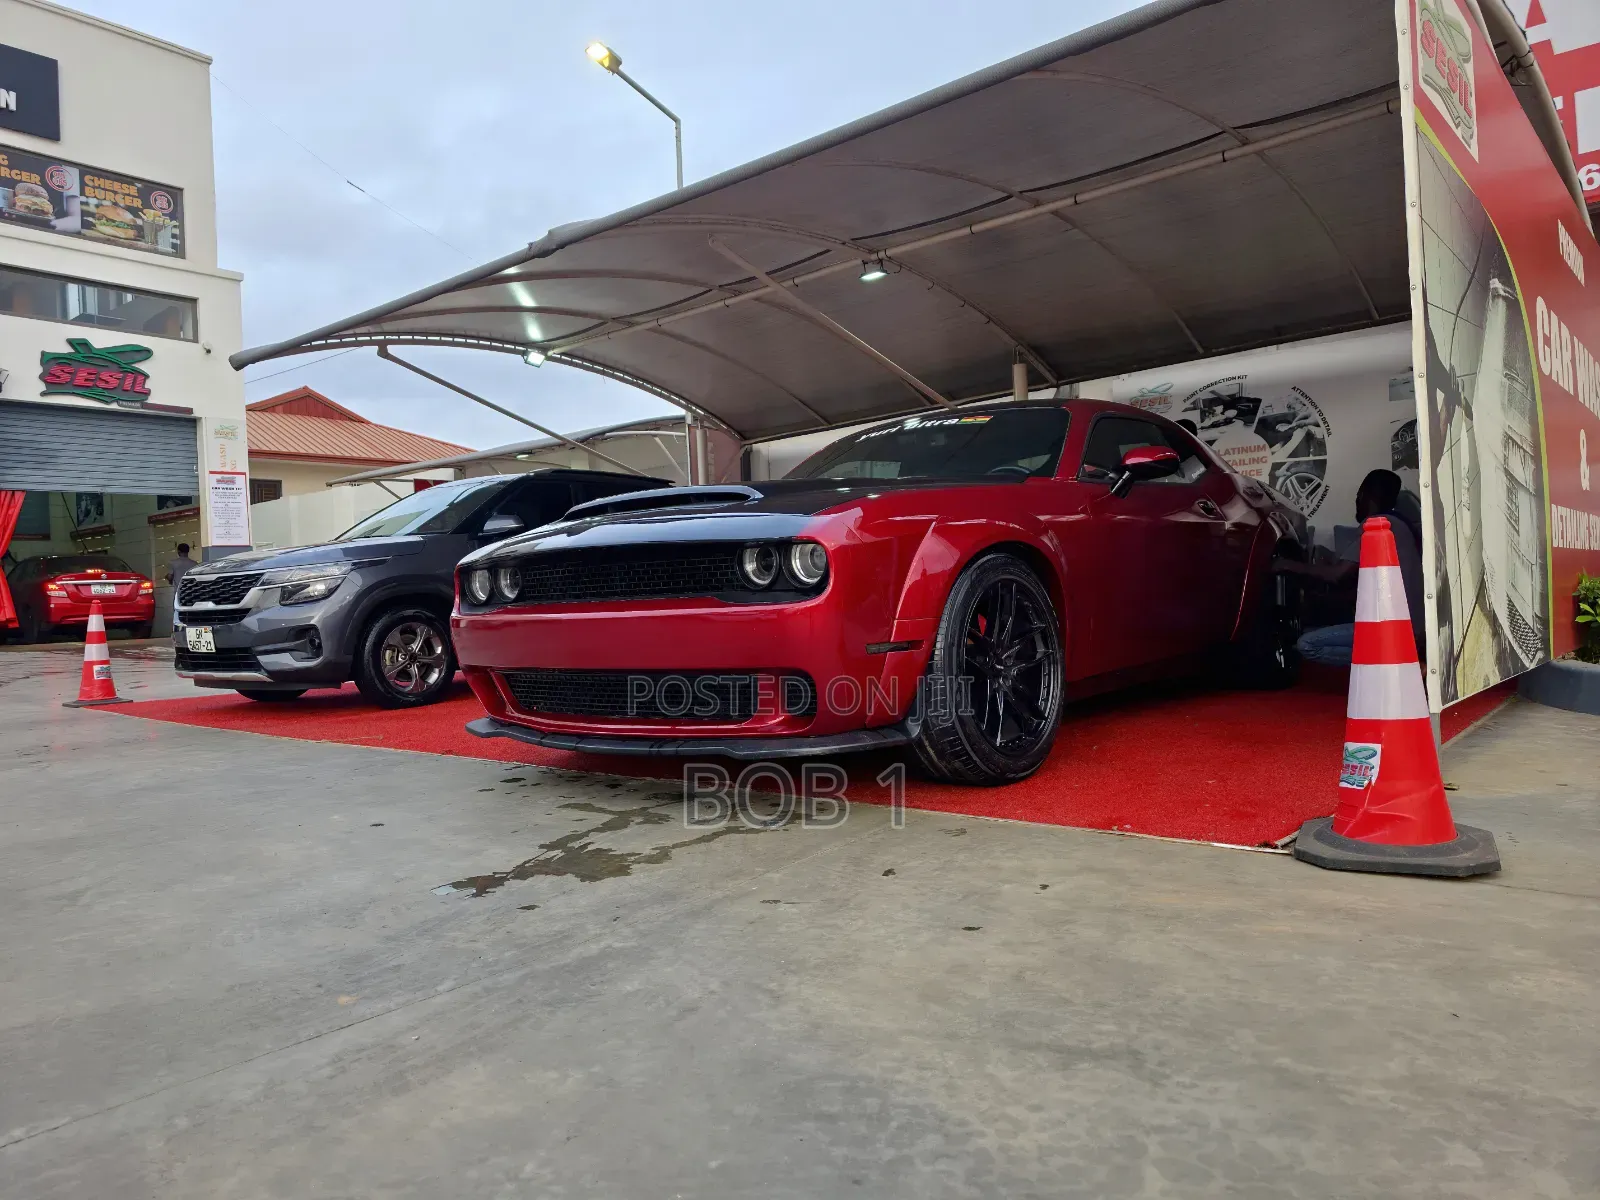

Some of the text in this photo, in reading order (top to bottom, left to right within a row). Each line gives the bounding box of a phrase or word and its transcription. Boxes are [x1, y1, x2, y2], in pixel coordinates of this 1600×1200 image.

[1420, 19, 1473, 119] SESIL
[84, 174, 138, 196] CHEESE
[84, 185, 143, 209] BURGER
[1536, 296, 1574, 395] CAR
[44, 364, 150, 394] SESIL
[1182, 389, 1201, 404] PAINT
[1198, 375, 1237, 393] CORRECTION
[1291, 385, 1332, 438] ATTENTION TO DETAIL
[1215, 443, 1267, 457] LATINUM
[1580, 428, 1590, 491] &
[1308, 484, 1330, 518] TREATMENT
